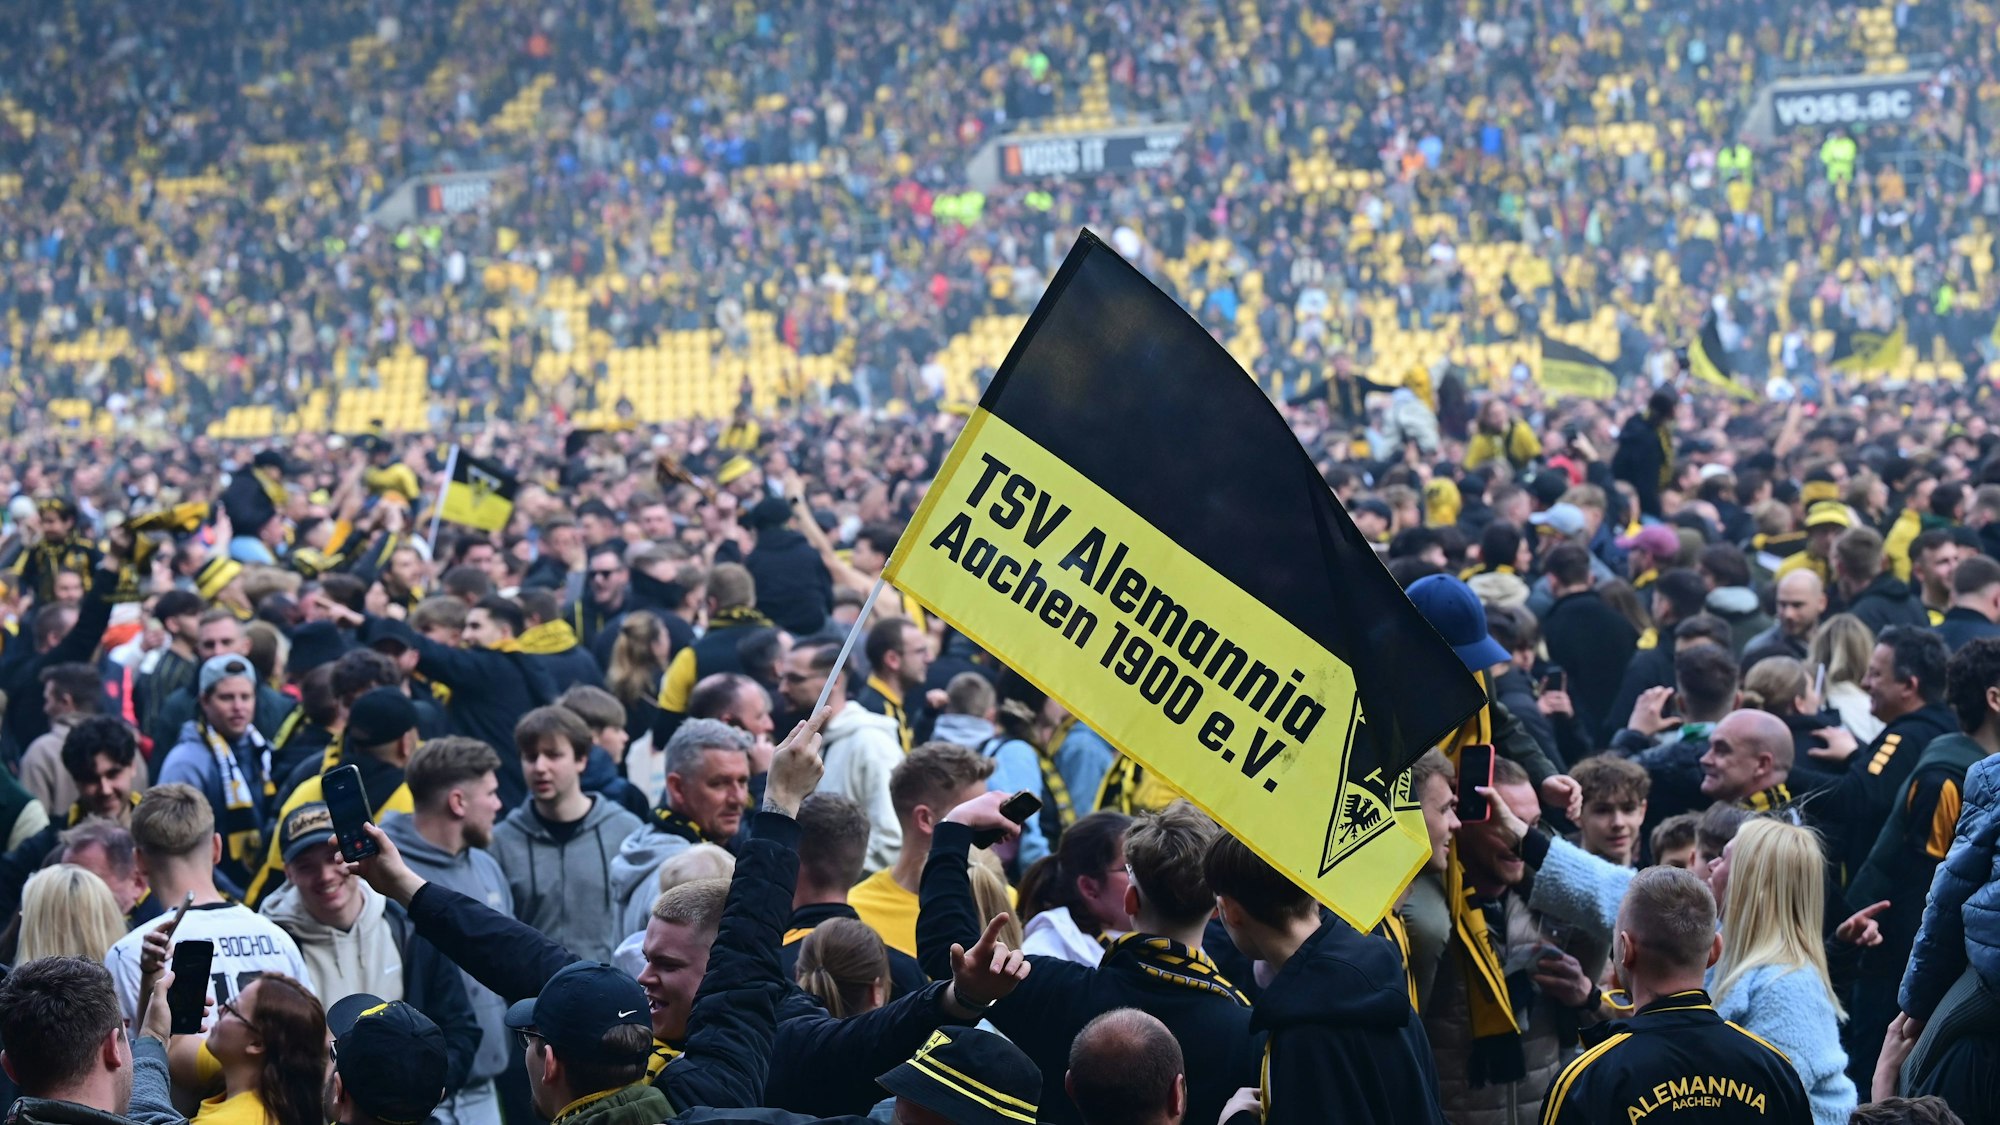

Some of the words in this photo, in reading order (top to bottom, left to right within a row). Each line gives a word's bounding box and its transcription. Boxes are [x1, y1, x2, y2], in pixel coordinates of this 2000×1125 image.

[966, 452, 1072, 549] TSV
[1058, 526, 1327, 745] Alemannia
[930, 511, 1099, 649] Aachen
[1099, 621, 1204, 725] 1900
[1198, 711, 1287, 793] e.V.
[218, 935, 286, 957] BOCHOL
[1627, 1075, 1766, 1125] ALEMANNIA
[1672, 1096, 1722, 1112] AACHEN
